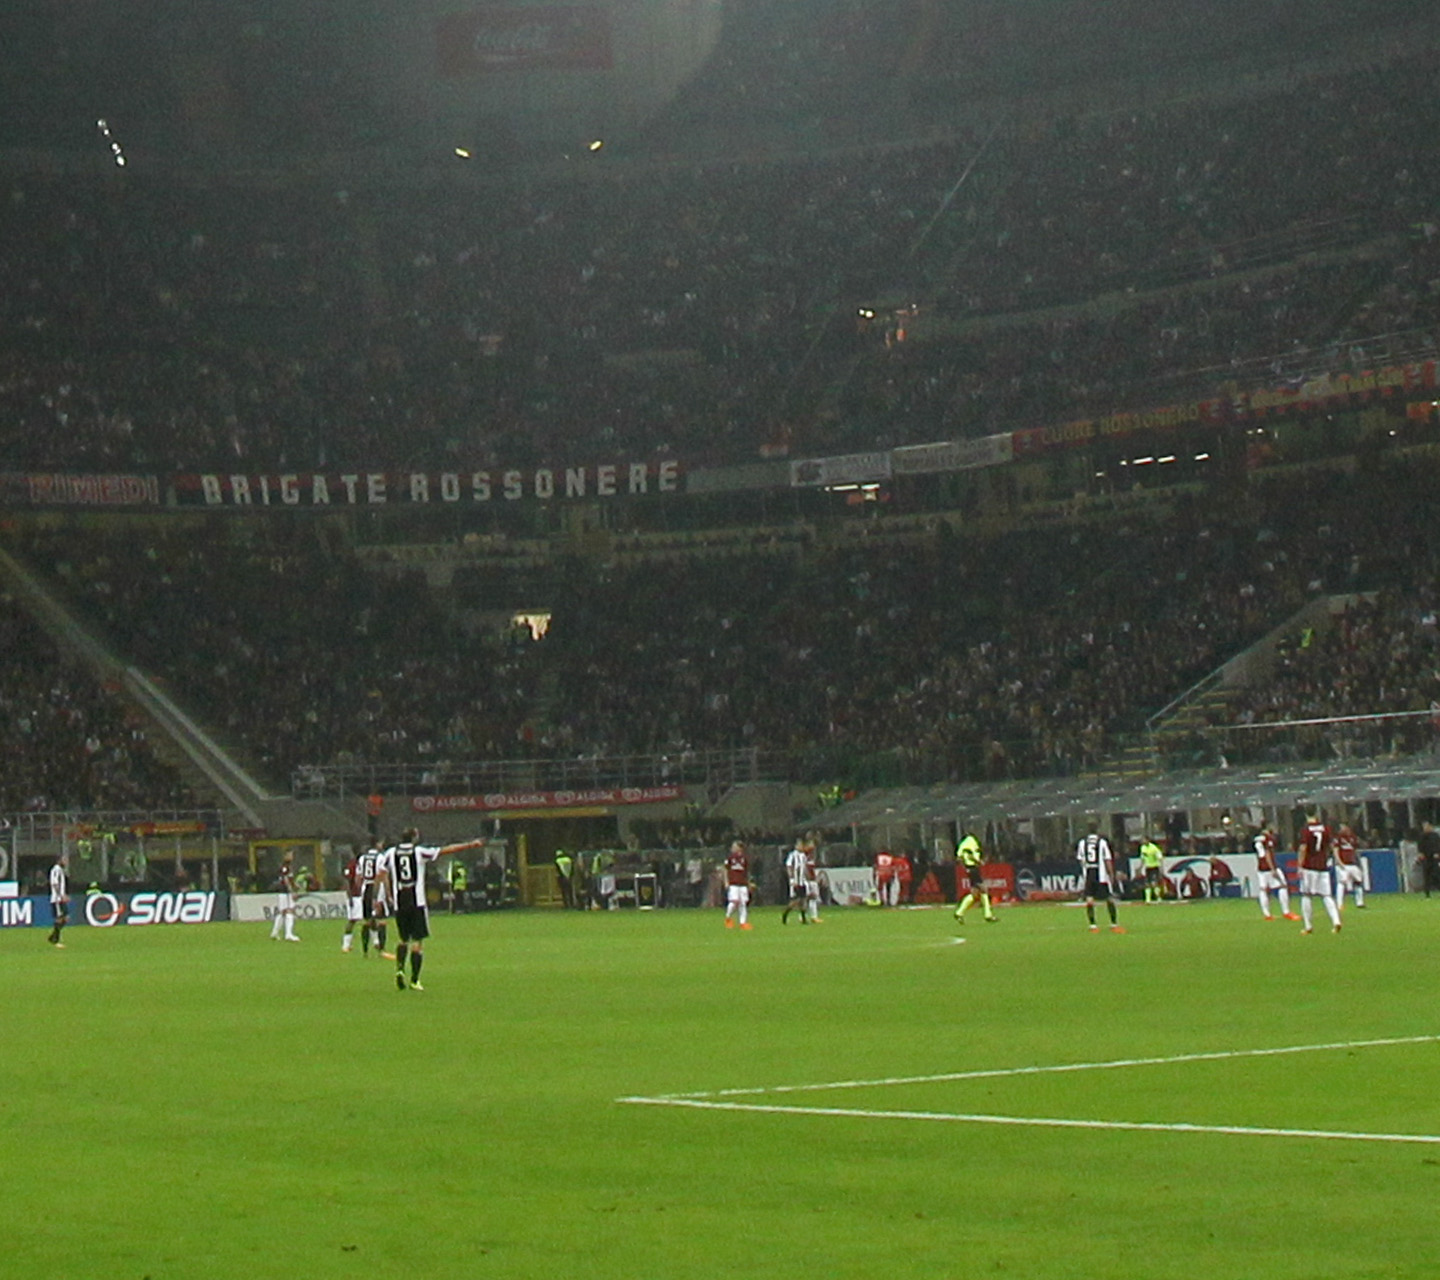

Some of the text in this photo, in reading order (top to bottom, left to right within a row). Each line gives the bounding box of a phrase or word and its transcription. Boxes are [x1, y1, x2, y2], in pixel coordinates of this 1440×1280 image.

[200, 460, 679, 505] BRIGATE ROSSONERE
[506, 792, 548, 806] ALGIDA
[576, 790, 617, 803] ALGIDA
[642, 788, 679, 799] ALGIDA
[436, 795, 476, 808] ALGIDA
[1313, 831, 1323, 851] 7
[1086, 844, 1097, 862] 5
[400, 860, 411, 880] 3
[264, 906, 316, 920] BACO
